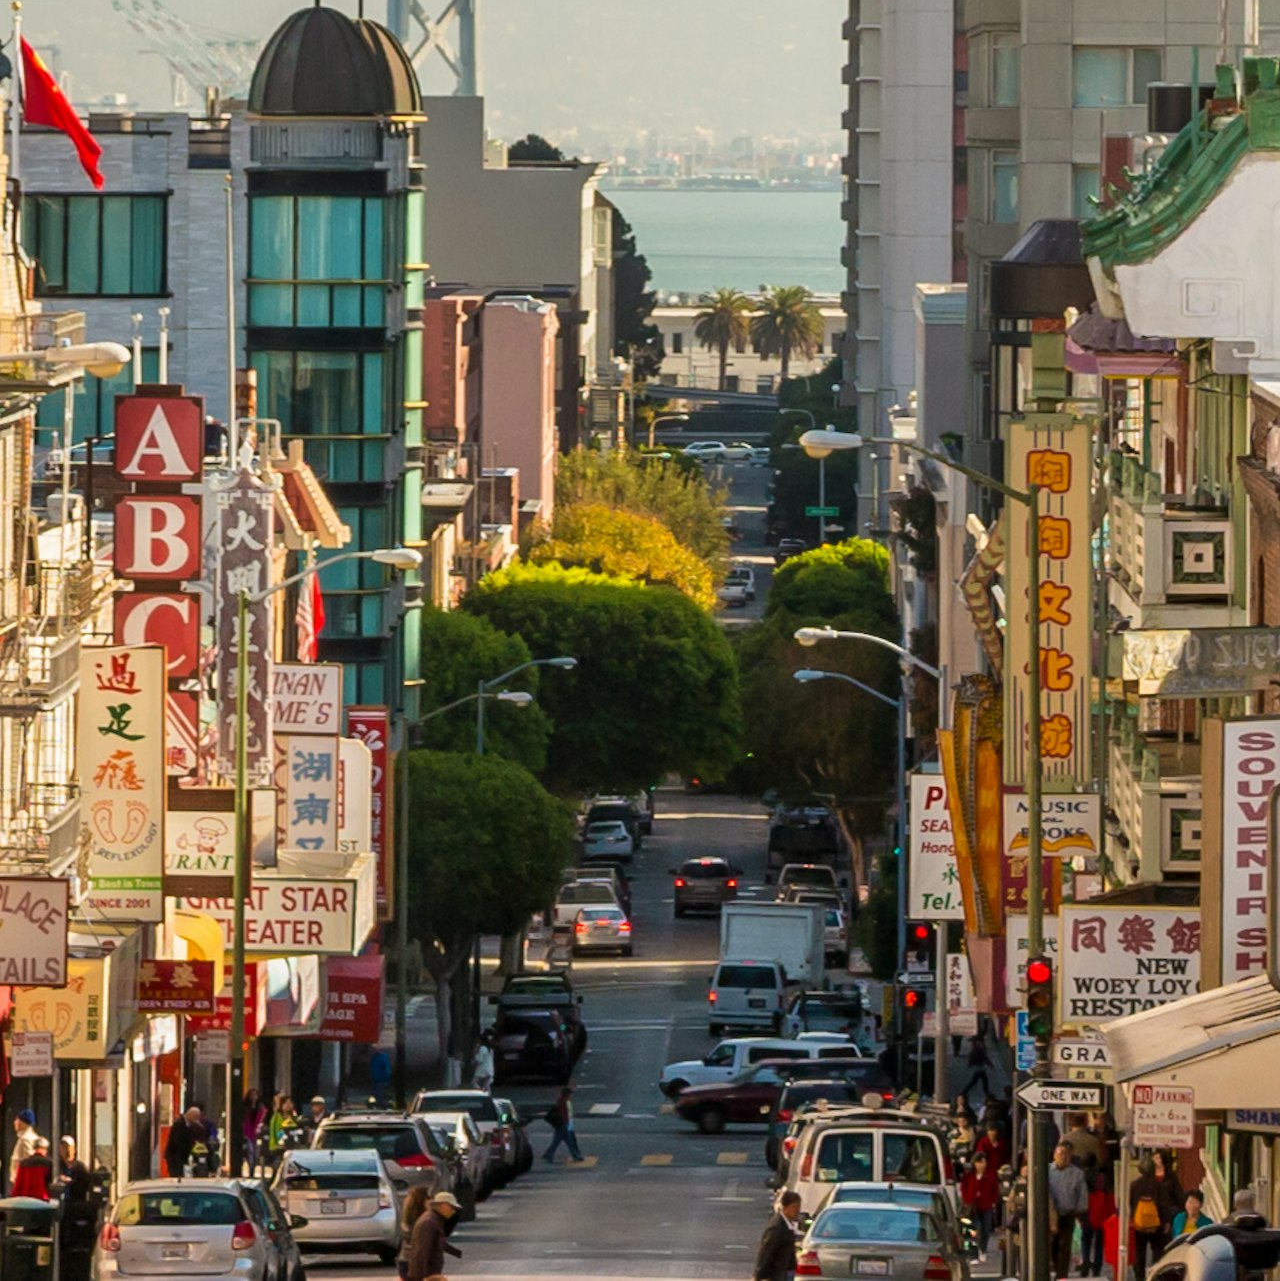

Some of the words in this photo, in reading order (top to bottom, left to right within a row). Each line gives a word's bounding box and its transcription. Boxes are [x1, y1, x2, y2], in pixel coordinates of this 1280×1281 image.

[89, 898, 123, 909] SINCE
[125, 898, 151, 909] 2001
[281, 888, 348, 913] STAR
[922, 893, 962, 910] Tel.
[1236, 927, 1268, 981] SH
[1135, 958, 1190, 976] NEW
[1073, 977, 1140, 995] WOEY
[1147, 977, 1193, 995] LOY
[342, 993, 368, 1005] SPA
[327, 1009, 355, 1021] AGE
[1060, 1047, 1108, 1063] GRA
[1041, 1089, 1066, 1102] ONE
[1070, 1090, 1097, 1103] WAY
[1135, 1085, 1153, 1105] NO
[1155, 1091, 1193, 1104] PARKING
[1138, 1108, 1146, 1119] 2
[1167, 1108, 1176, 1119] 6
